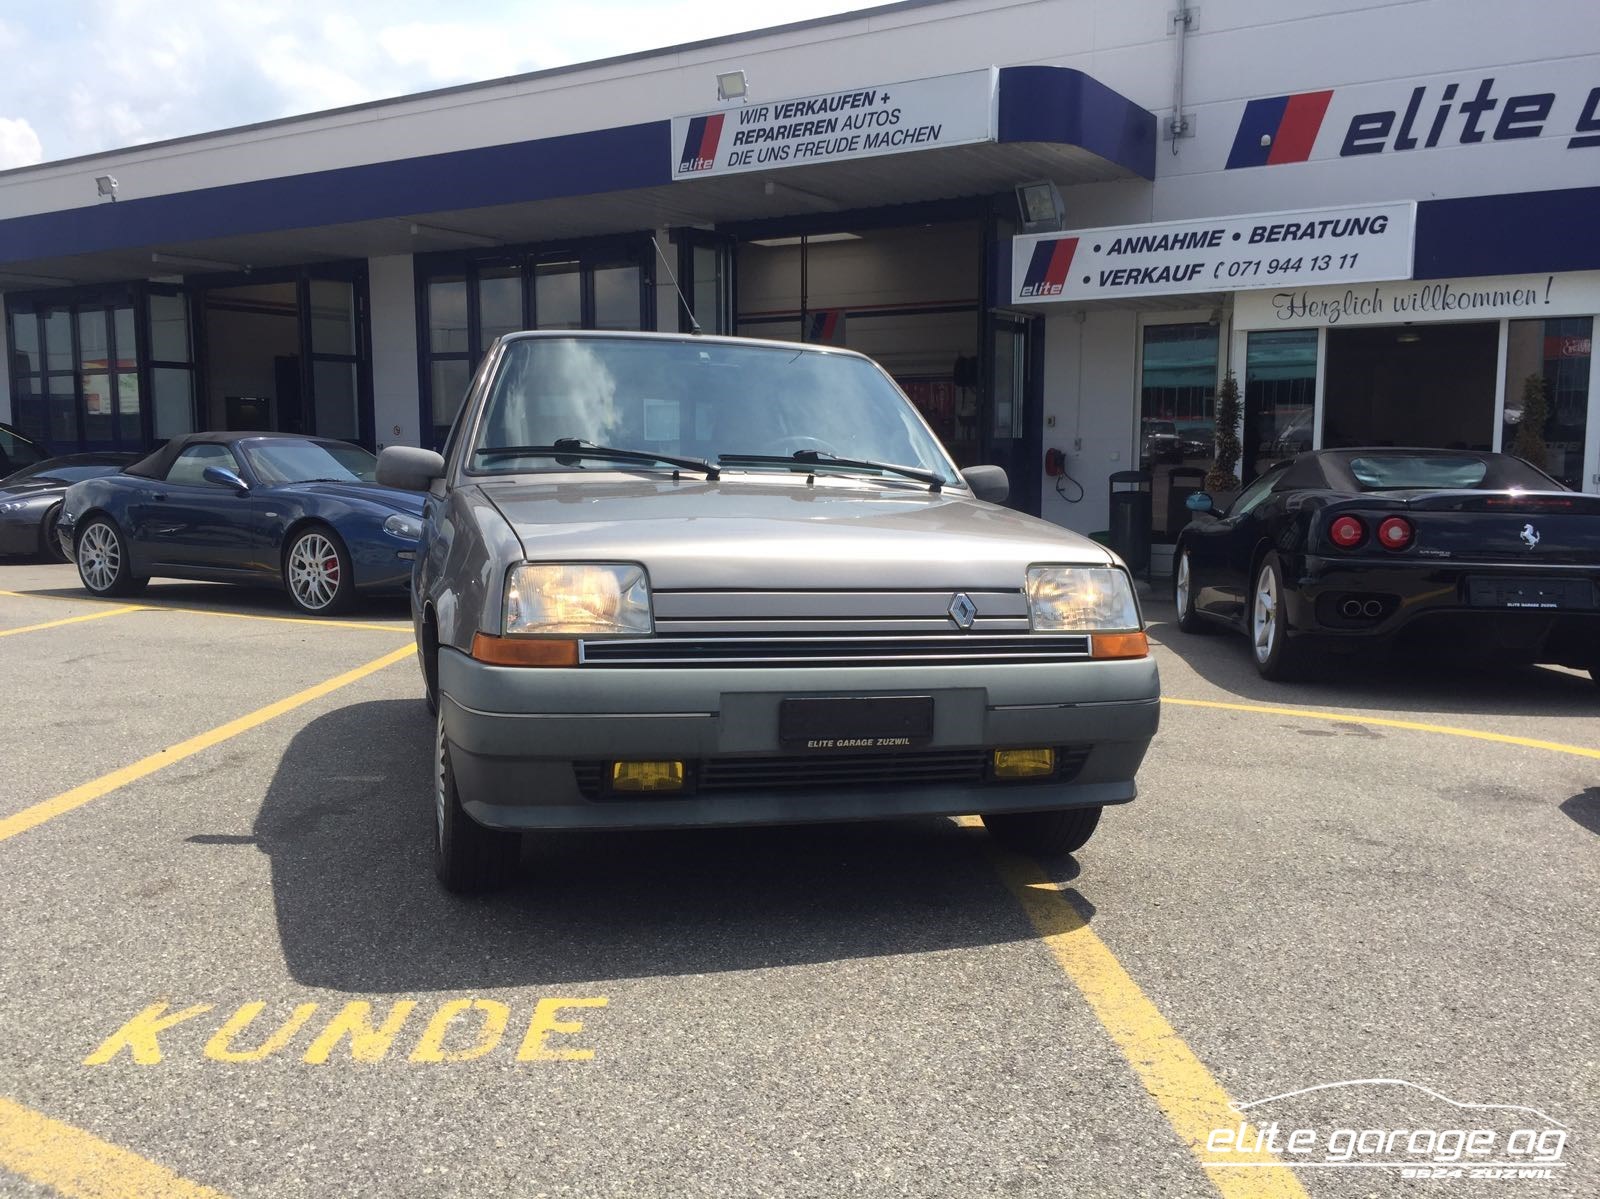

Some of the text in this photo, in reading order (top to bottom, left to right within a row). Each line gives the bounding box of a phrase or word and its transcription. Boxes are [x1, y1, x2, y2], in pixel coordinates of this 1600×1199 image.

[739, 107, 769, 126] WIR
[774, 90, 877, 121] VERKAUFEN
[1339, 78, 1556, 157] elite
[733, 108, 901, 146] REPARIEREN AUTOS
[727, 124, 942, 167] DIE UNS FREUDE MACHEN
[679, 157, 714, 173] elite
[1106, 214, 1389, 257] ANNAHME BERATUNG
[1099, 252, 1359, 288] VERKAUF 071 944 13 11
[1020, 281, 1063, 296] elite
[1271, 287, 1384, 323] Herzlich
[807, 737, 910, 748] ELITE GARAGE ZUZWIL
[81, 997, 610, 1066] KUNDE
